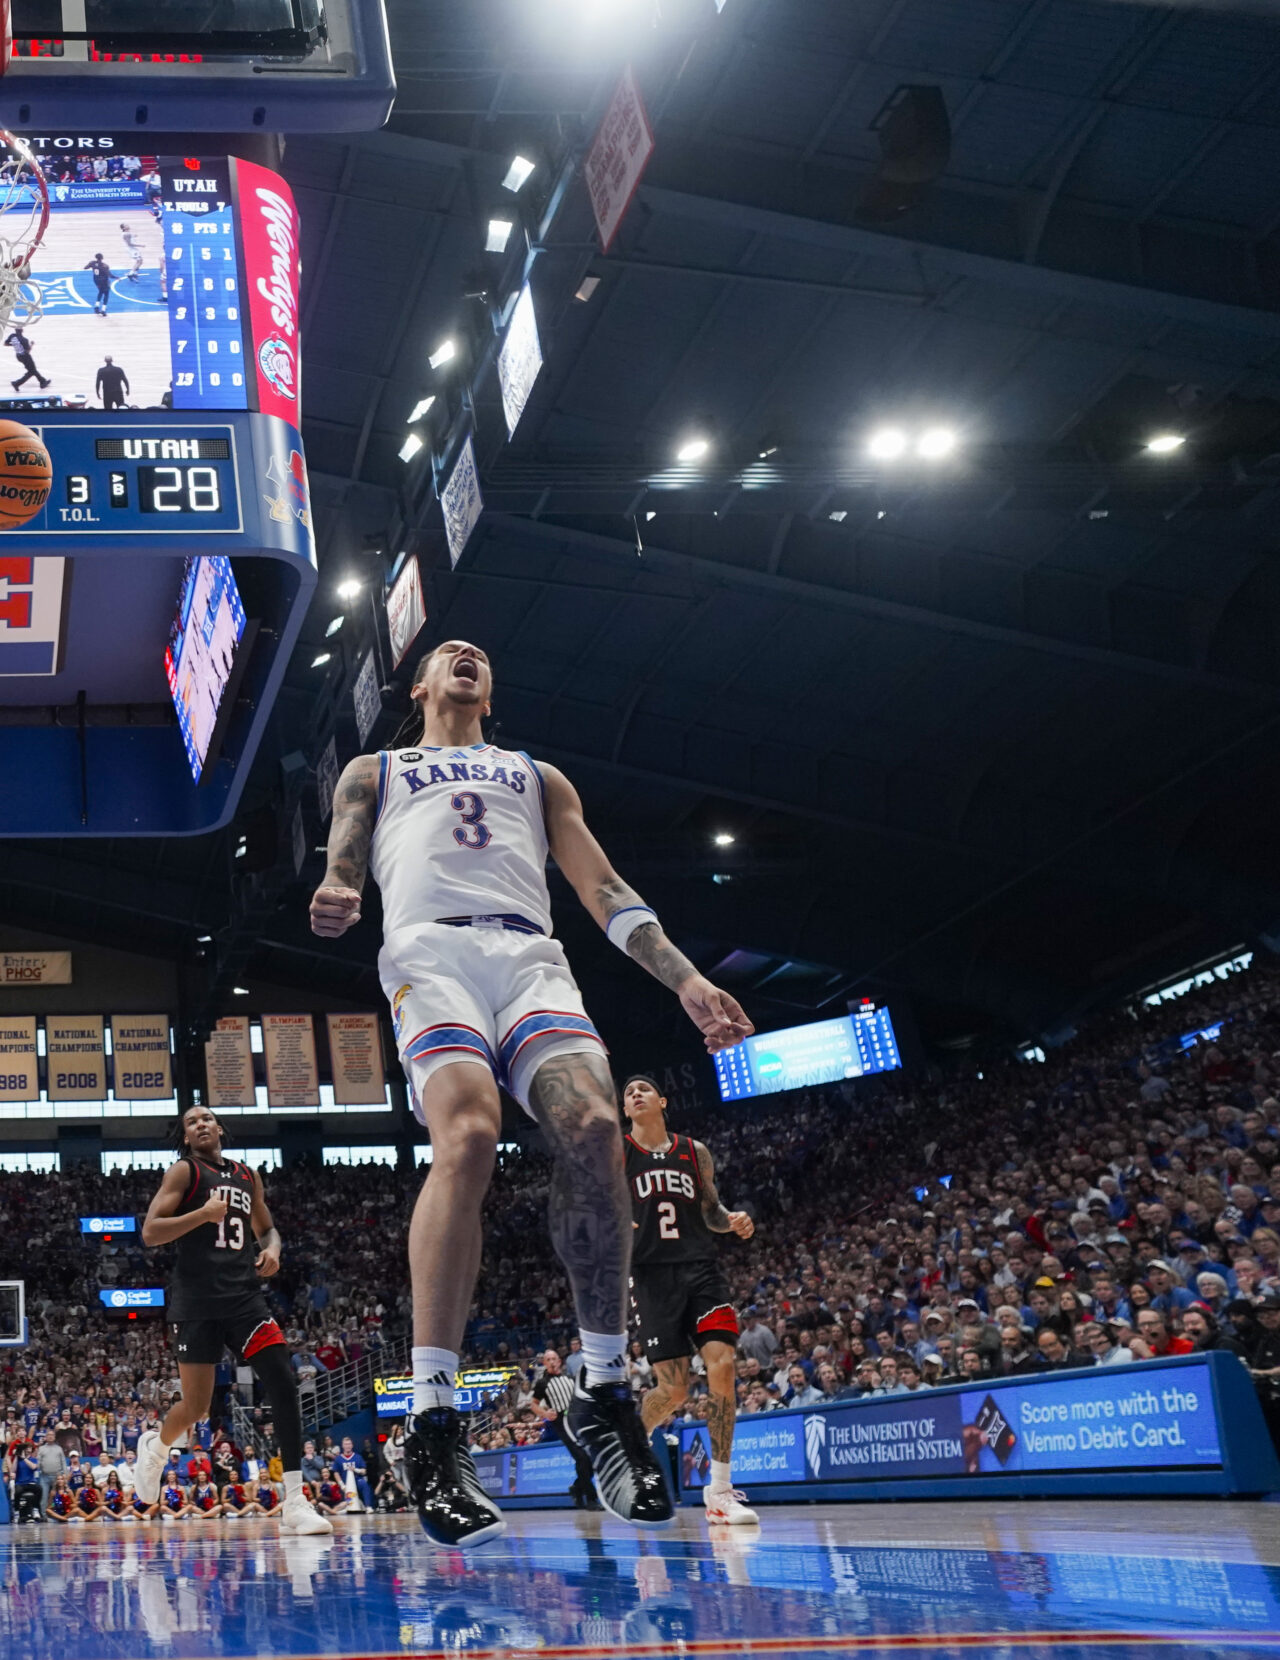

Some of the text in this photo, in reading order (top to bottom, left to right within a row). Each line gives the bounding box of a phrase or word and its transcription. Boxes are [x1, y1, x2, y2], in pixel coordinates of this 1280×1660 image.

[173, 179, 217, 193] UTAH
[175, 202, 209, 212] FOULS
[217, 202, 225, 213] 7
[193, 223, 217, 234] PTS
[172, 248, 232, 260] 0 5 1
[255, 187, 295, 336] Wendy's
[172, 278, 235, 291] 2 8 0
[176, 308, 237, 320] 3 3 0
[177, 340, 240, 353] 7 0 0
[176, 373, 243, 386] 13 0 0
[123, 439, 199, 459] UTAH
[4, 451, 47, 468] NCAA
[71, 477, 88, 503] 3
[153, 467, 220, 511] 28
[59, 508, 100, 522] T.O.L.
[400, 763, 527, 794] KANSAS
[451, 791, 492, 849] 3
[54, 1030, 97, 1039] NATIONAL
[120, 1028, 163, 1038] NATIONAL
[49, 1043, 103, 1053] CHAMPIONS
[115, 1041, 168, 1052] CHAMPIONS
[56, 1073, 98, 1089] 2008
[122, 1072, 165, 1088] 2022
[635, 1169, 695, 1199] UTES
[210, 1185, 252, 1215] UTES
[657, 1201, 680, 1239] 2
[215, 1216, 244, 1251] 13
[1021, 1387, 1199, 1425] Score more with the
[737, 1430, 796, 1451] more with the
[829, 1418, 936, 1445] THE UNIVERSITY OF
[1023, 1420, 1186, 1453] Venmo Debit Card.
[830, 1438, 963, 1466] KANSAS HEALTH SYSTEM
[740, 1453, 789, 1472] Debit Card.
